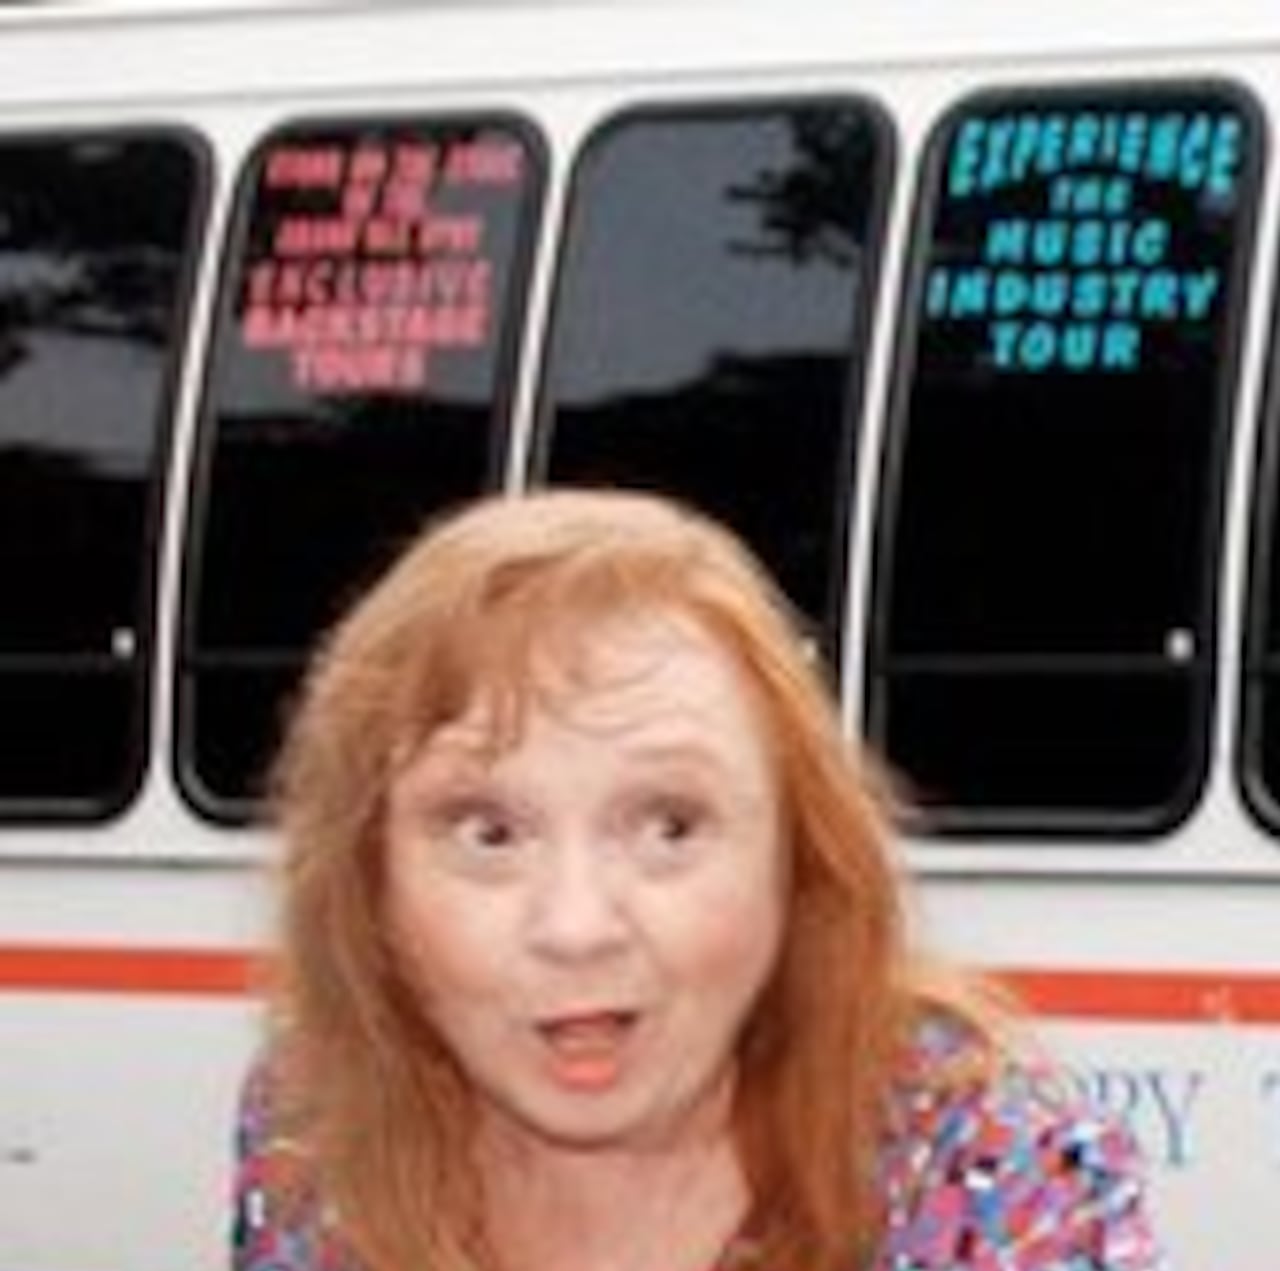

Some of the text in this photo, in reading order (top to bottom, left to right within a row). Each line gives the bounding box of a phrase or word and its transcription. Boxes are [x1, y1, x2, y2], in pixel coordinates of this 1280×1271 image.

[949, 110, 1241, 196] EXPERIENCE
[1050, 174, 1132, 212] THE
[985, 217, 1170, 266] MUSIC
[926, 265, 1220, 320] INDUSTRY
[992, 320, 1140, 370] TOUR
